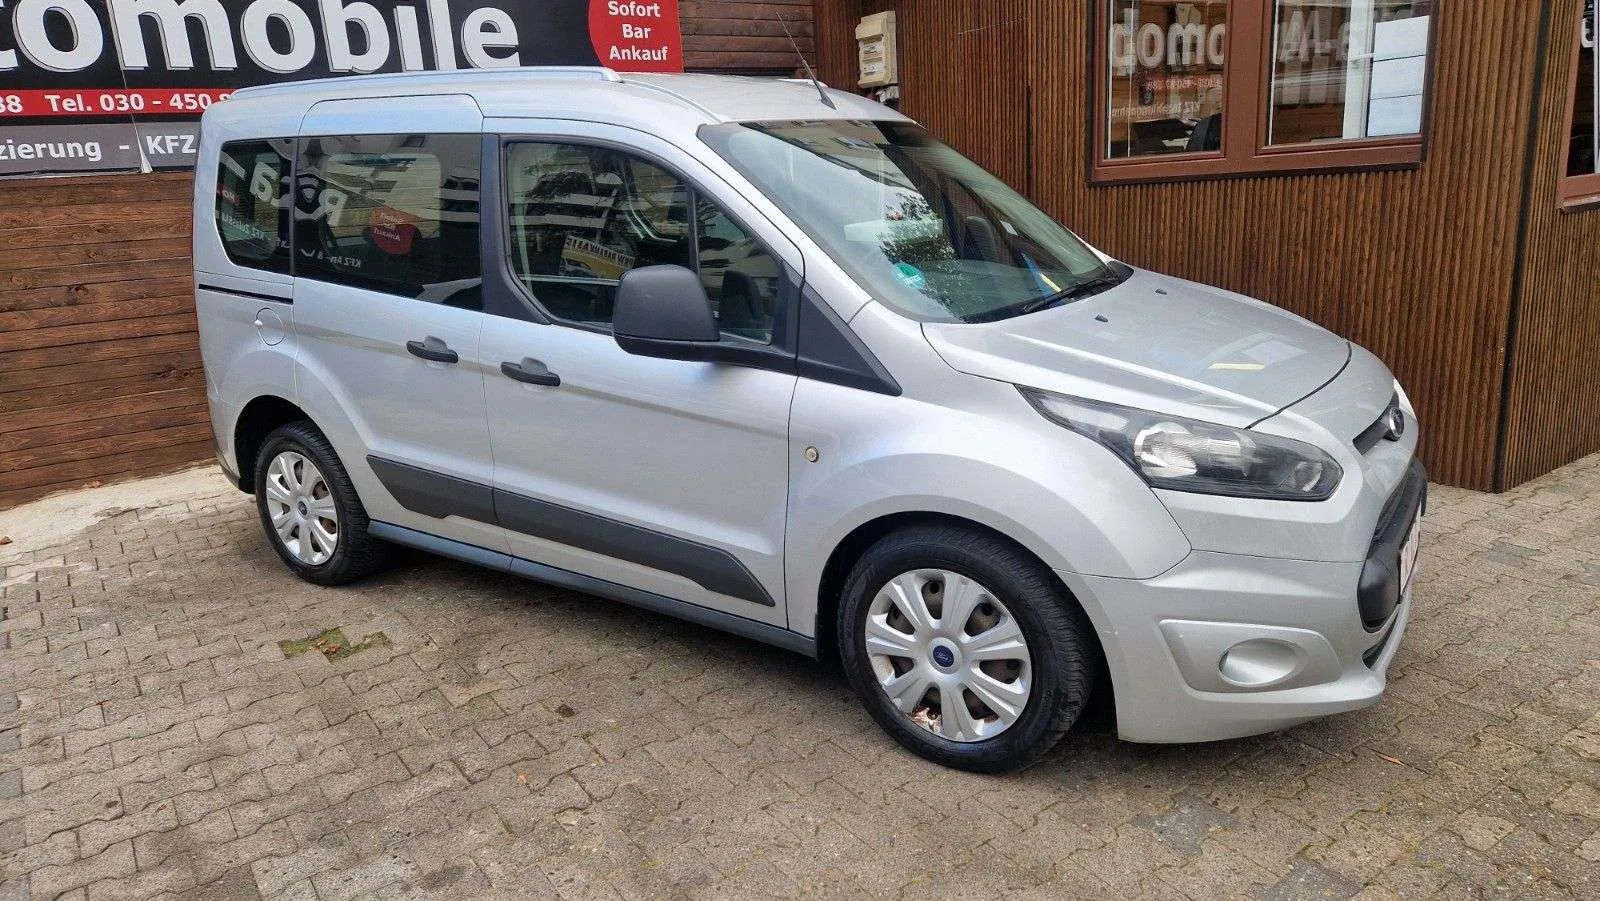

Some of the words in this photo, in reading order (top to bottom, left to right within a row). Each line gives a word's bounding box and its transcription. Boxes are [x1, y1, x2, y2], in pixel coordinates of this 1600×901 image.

[608, 0, 661, 17] Sofort
[622, 23, 651, 39] Bar
[609, 45, 668, 61] Ankauf
[44, 94, 92, 112] Tel.
[101, 94, 145, 111] 030
[169, 93, 212, 110] 450
[0, 138, 101, 161] zierung
[146, 134, 197, 155] KFZ
